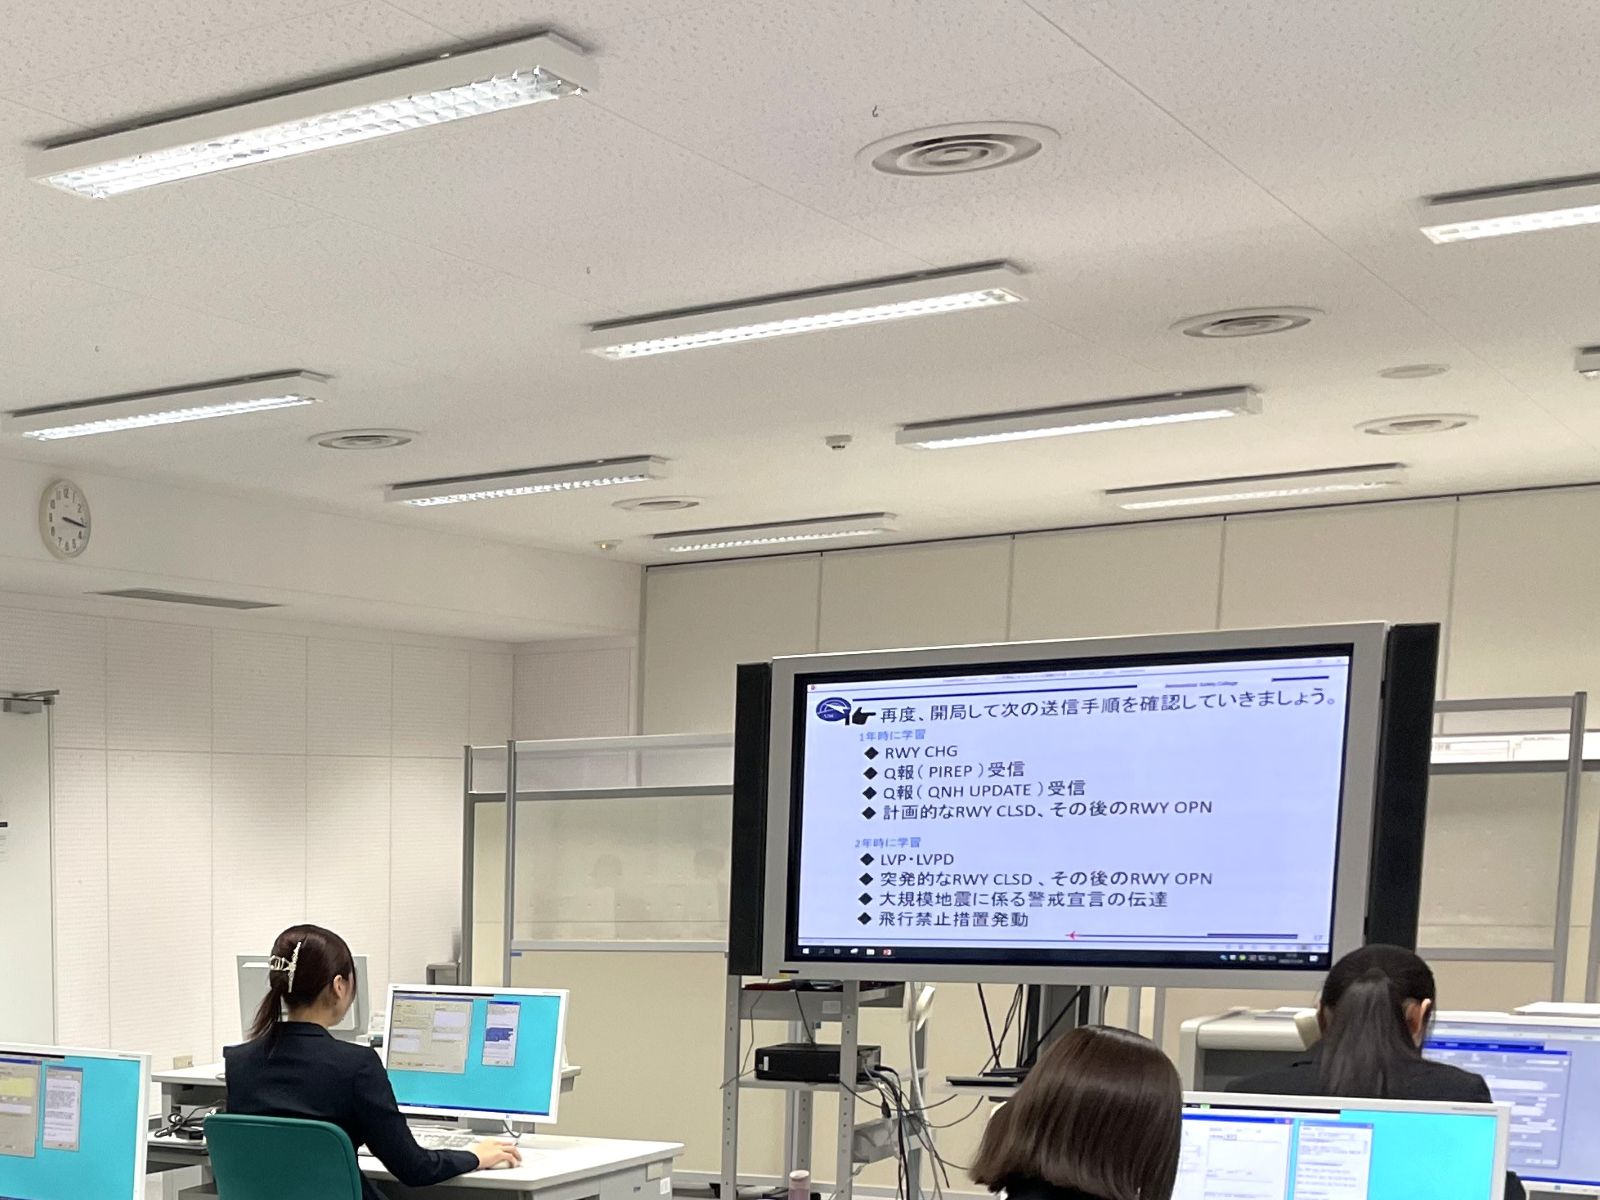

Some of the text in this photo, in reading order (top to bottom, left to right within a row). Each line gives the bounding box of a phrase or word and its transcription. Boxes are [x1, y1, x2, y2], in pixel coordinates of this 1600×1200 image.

[880, 687, 1335, 723] 再度、開局して次の送信手順を確認していきましょう。
[885, 745, 958, 759] RWY CHG
[969, 784, 1032, 797] UPDATE
[883, 803, 992, 820] 計画的なRWY
[1174, 801, 1213, 814] OPN
[880, 853, 955, 866] LVP・LVPD
[880, 871, 989, 887] 突発的なRWY
[1174, 872, 1213, 886] OPN
[879, 890, 1168, 909] 大規模地震に係る警戒宣言の伝達
[878, 911, 1029, 928] 飛行禁止措置発動
